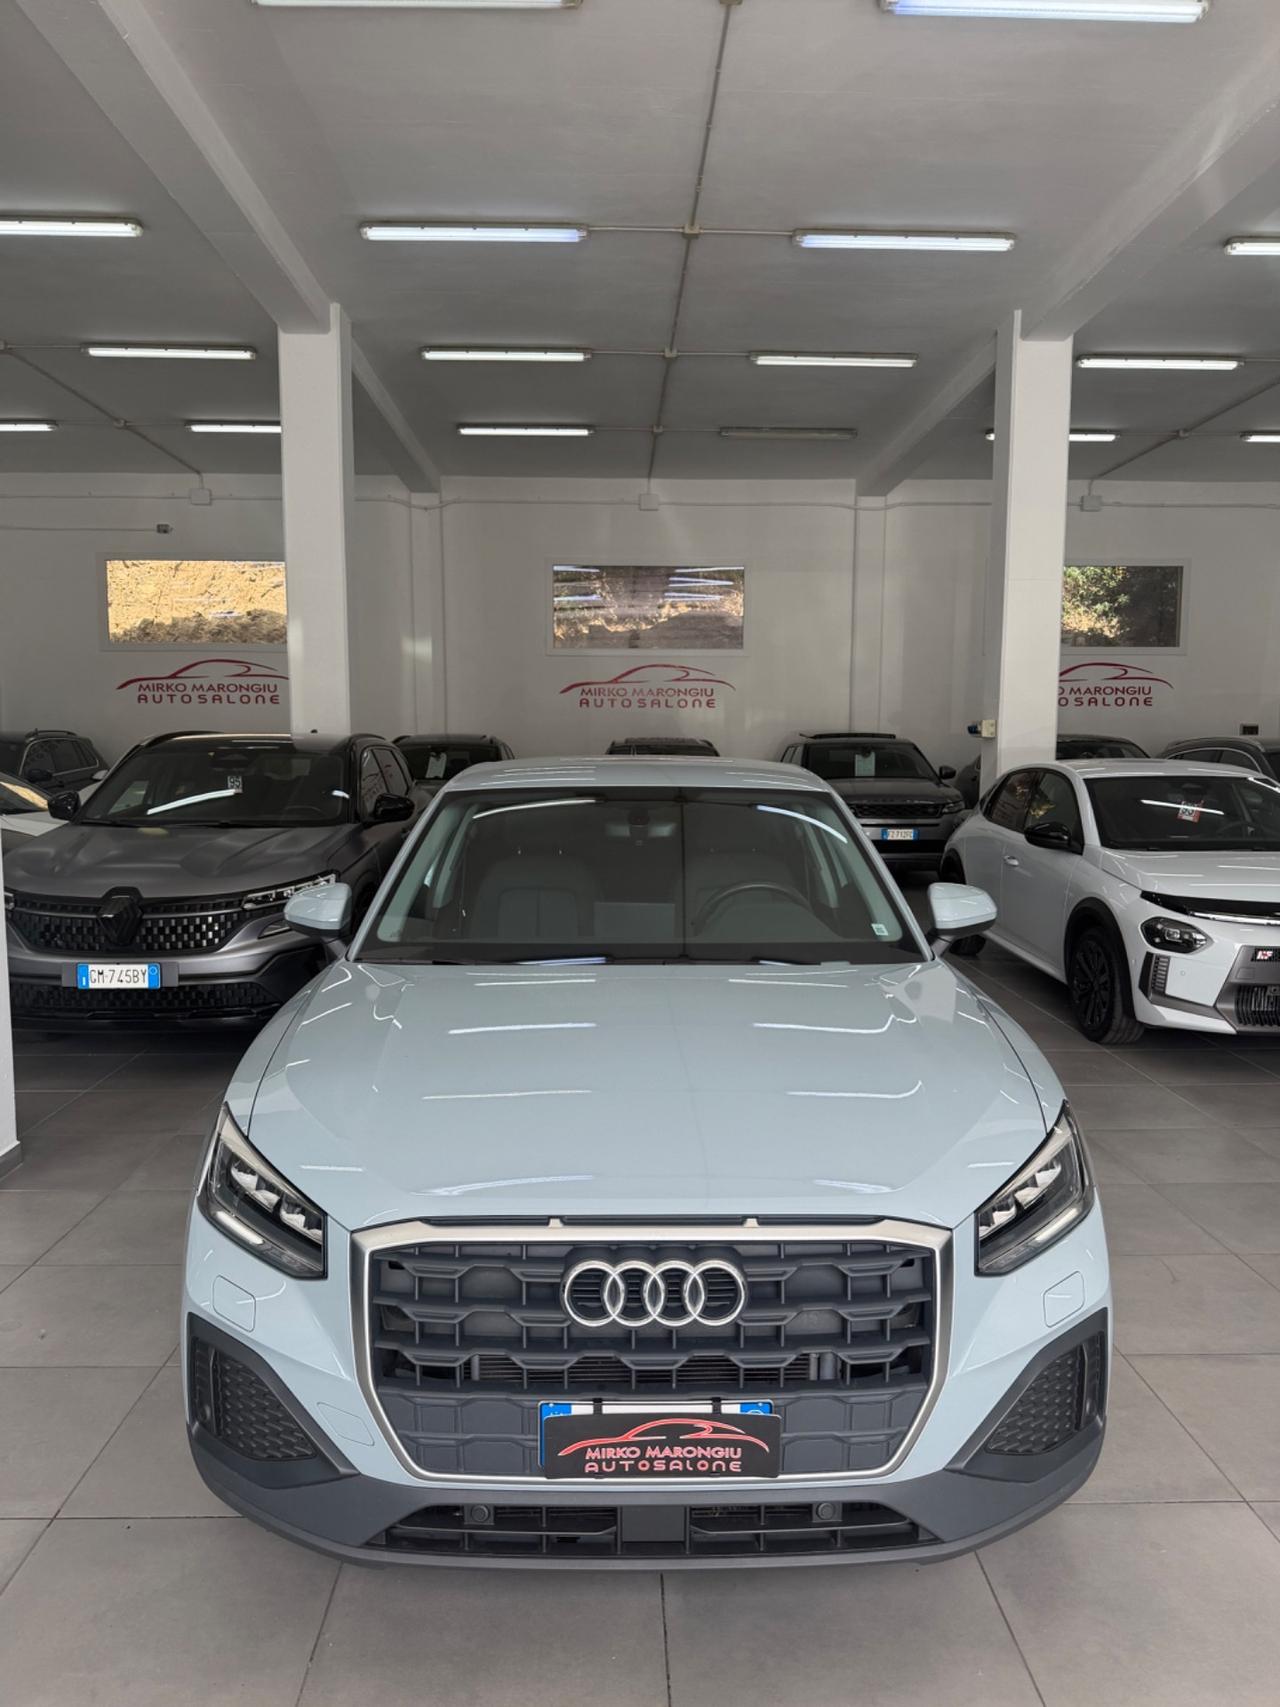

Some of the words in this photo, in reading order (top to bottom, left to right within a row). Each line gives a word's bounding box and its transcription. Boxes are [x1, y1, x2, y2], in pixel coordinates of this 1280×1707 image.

[138, 683, 187, 693] MIRKO
[191, 683, 278, 693] MARONGIU
[580, 687, 627, 697] MIRKO
[632, 687, 715, 697] MARONGIU
[1069, 686, 1152, 696] MARONGIU
[137, 694, 280, 704] AUTOSALONE
[579, 698, 716, 709] AUTOSALONE
[1058, 697, 1153, 707] OSALONE
[585, 1446, 641, 1460] MIRKO
[645, 1446, 742, 1460] MARONGIU
[585, 1460, 742, 1473] AUTOSALONE
